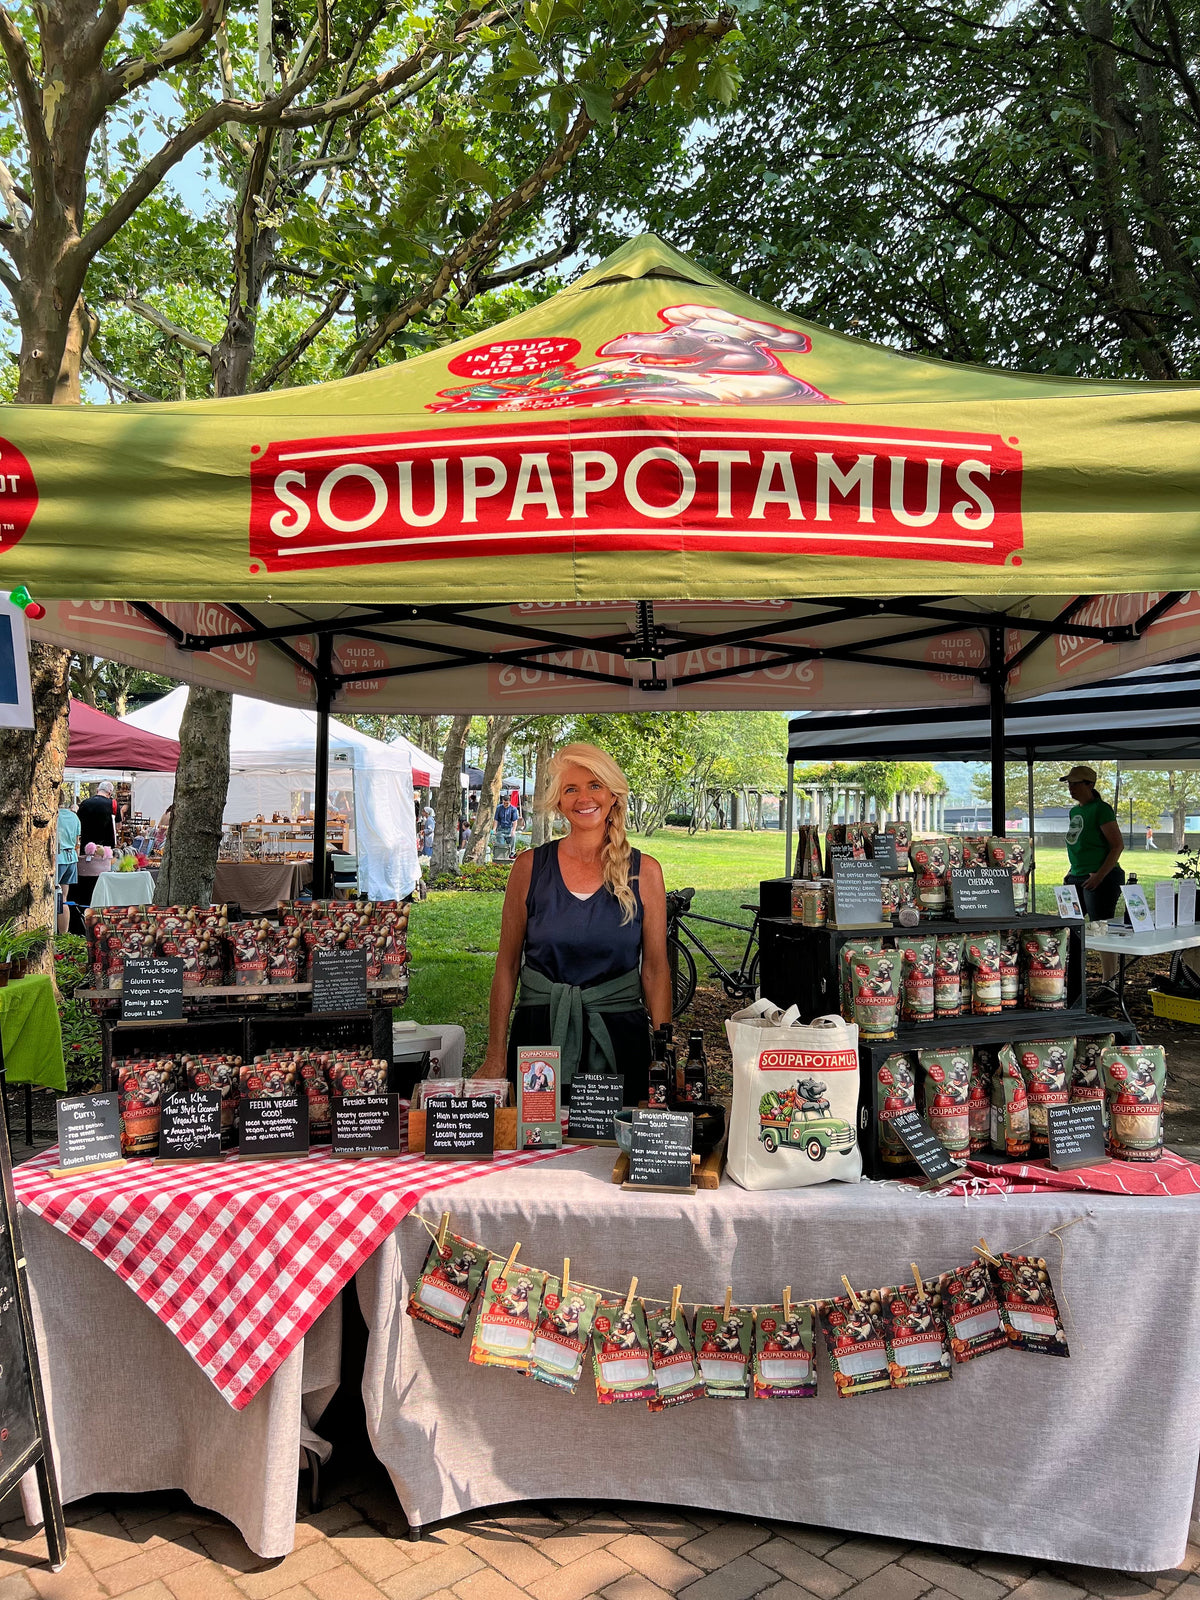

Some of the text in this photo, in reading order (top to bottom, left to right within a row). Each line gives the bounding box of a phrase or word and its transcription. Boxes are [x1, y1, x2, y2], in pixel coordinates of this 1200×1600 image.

[466, 343, 569, 363] IN A POT
[489, 341, 551, 354] SOUP
[490, 356, 539, 368] IS A
[269, 446, 995, 539] SOUPAPOTAMUS
[952, 868, 1009, 878] CREAMY BROCCOLI
[968, 878, 994, 886] CHEDDAR
[130, 988, 150, 996] Vegan
[761, 1053, 856, 1066] SOUPAPOTAMUS
[166, 1092, 209, 1105] Tom Kha
[250, 1099, 298, 1109] FEELIN VEGGIE
[342, 1097, 388, 1106] Fireside Barley
[451, 1099, 468, 1108] BLAST
[60, 1098, 111, 1112] Gimme Some
[163, 1106, 179, 1115] Thai
[180, 1105, 197, 1115] Style
[74, 1110, 96, 1120] Curry
[261, 1109, 283, 1118] GOOD!
[460, 1112, 489, 1121] probiotics
[1050, 1109, 1070, 1118] Creamy
[435, 1132, 457, 1141] Locally
[793, 1129, 800, 1140] S
[63, 1157, 85, 1166] Gluten
[424, 1275, 471, 1302] SOUPAPOTAMUS
[951, 1302, 998, 1322] SOUPAPOTAMUS
[1004, 1302, 1055, 1316] SOUPAPOTAMUS
[483, 1314, 534, 1329] SOUPAPOTAMUS
[892, 1335, 942, 1347] SOUPAPOTAMUS
[834, 1341, 885, 1356] SOUPAPOTAMUS
[598, 1350, 648, 1361] SOUPAPOTAMUS
[759, 1352, 811, 1360] SOUPAPOTAMUS
